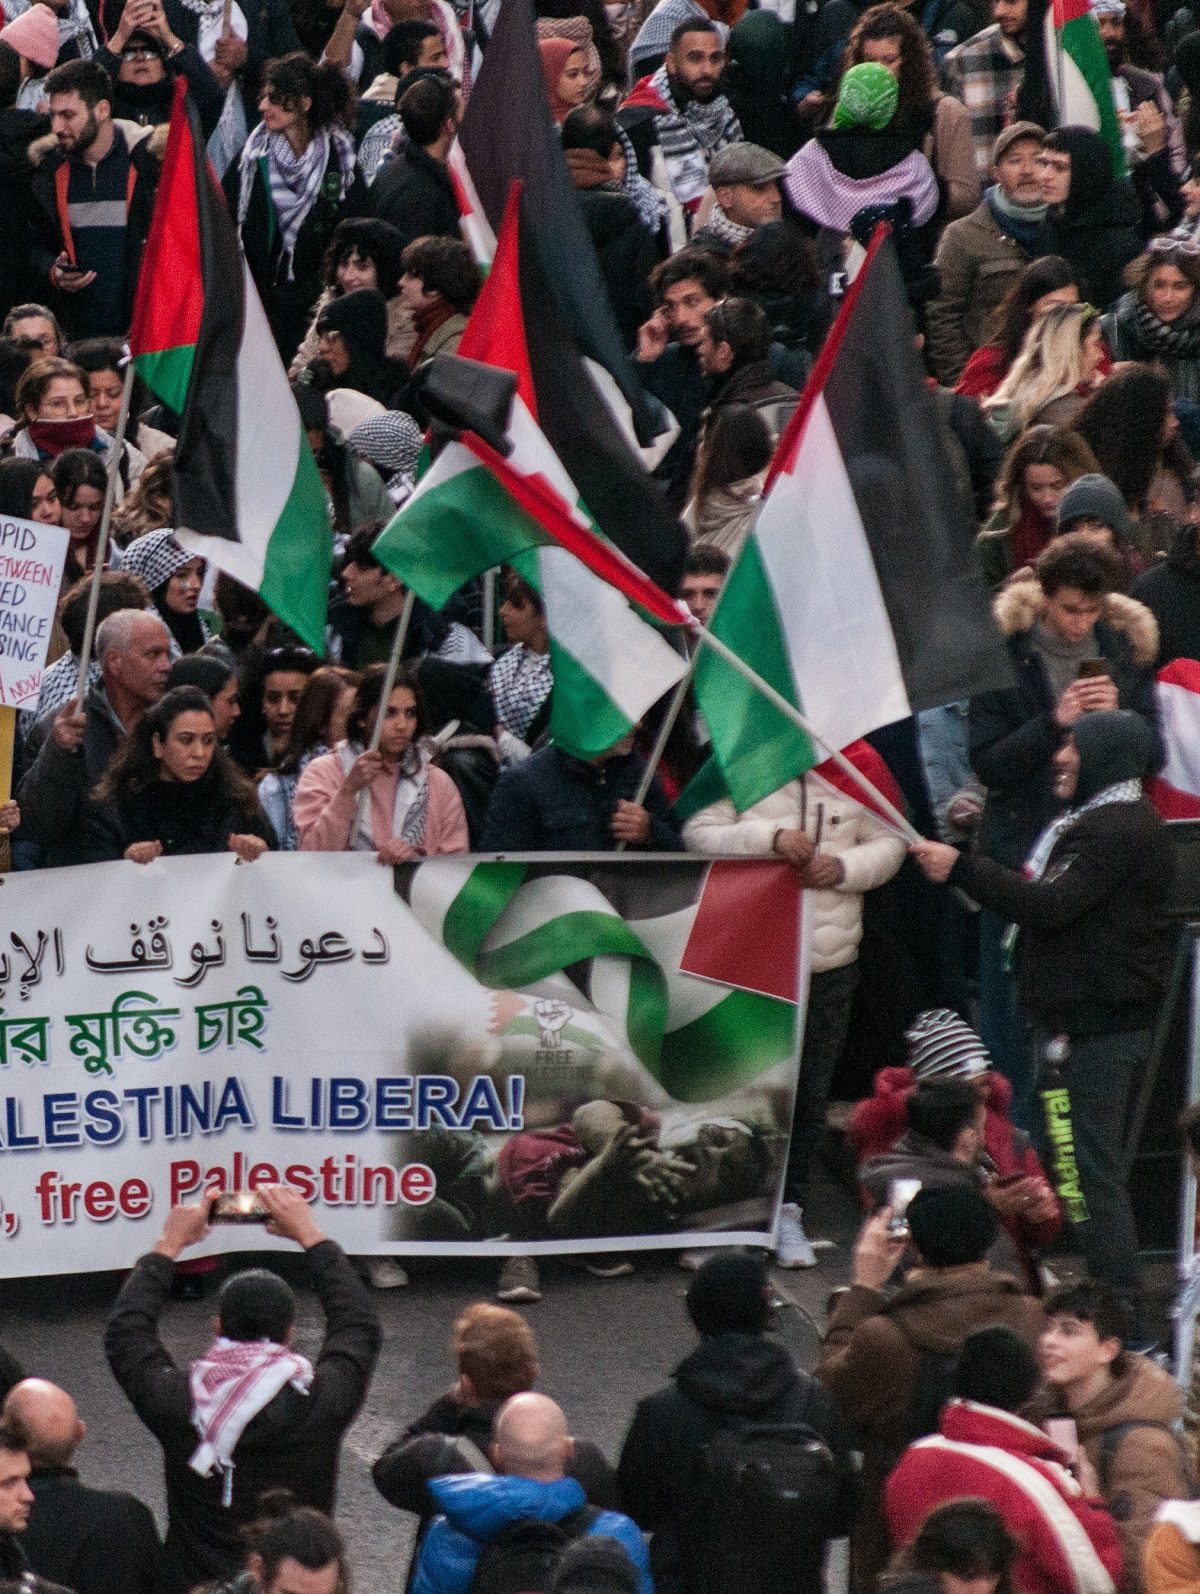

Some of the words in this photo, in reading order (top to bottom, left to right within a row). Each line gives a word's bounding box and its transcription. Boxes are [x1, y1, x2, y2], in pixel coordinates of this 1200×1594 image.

[9, 670, 41, 698] NOW
[65, 990, 180, 1074] মুক্তি
[195, 986, 269, 1051] চাই
[536, 1050, 573, 1065] FREE
[271, 1075, 525, 1129] LIBERA!
[1039, 1088, 1084, 1198] Admiral
[35, 1171, 150, 1224] free
[170, 1151, 435, 1209] Palestine
